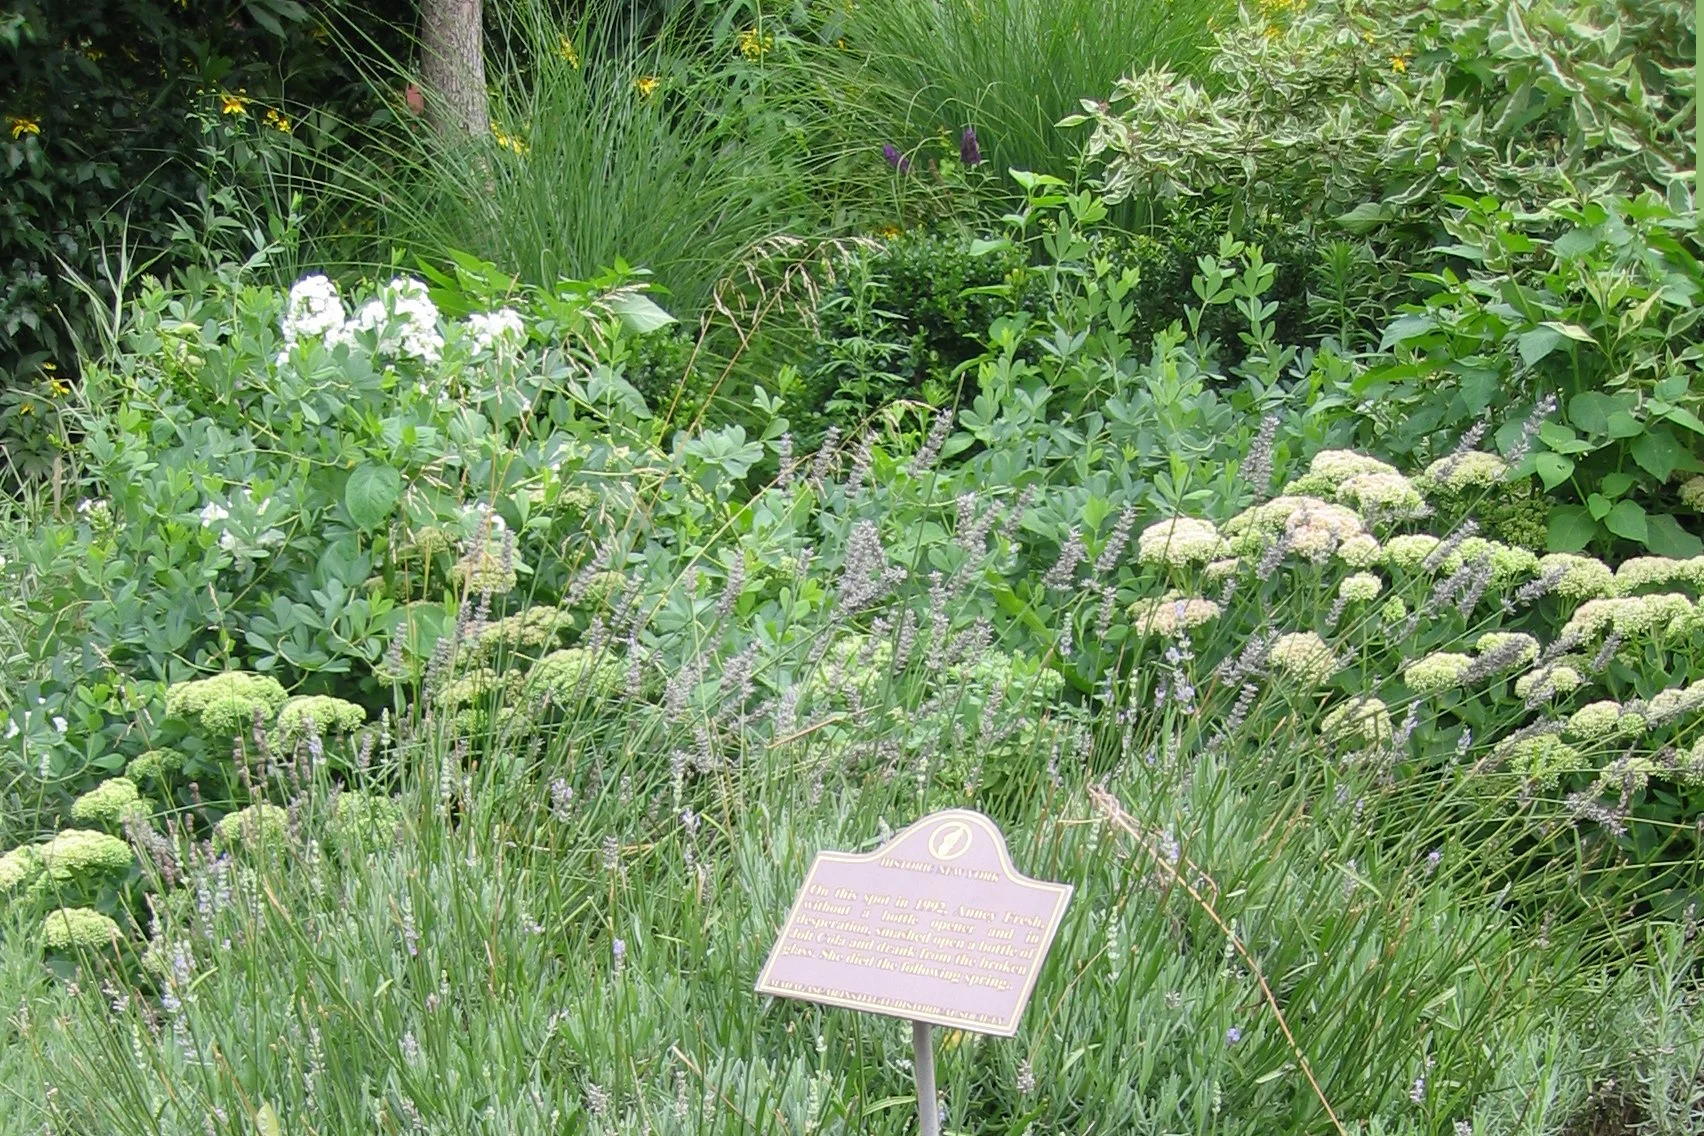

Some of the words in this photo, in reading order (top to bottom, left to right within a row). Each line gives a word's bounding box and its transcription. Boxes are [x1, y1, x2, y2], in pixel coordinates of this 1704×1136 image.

[880, 857, 934, 873] HISTORIC
[936, 866, 965, 876] NEW
[966, 869, 999, 882] YORK
[808, 884, 829, 896] On
[833, 888, 857, 900] this
[863, 894, 890, 907] spot
[894, 896, 908, 908] in
[803, 900, 851, 915] without
[881, 910, 918, 925] bottle
[930, 920, 975, 935] opener
[988, 926, 1014, 940] and
[1025, 931, 1039, 944] in
[788, 928, 815, 941] Jolt
[816, 933, 845, 947] Cola
[848, 939, 873, 951] and
[876, 940, 916, 958] drank
[918, 949, 951, 963] from
[954, 953, 976, 967] the
[979, 957, 1027, 975] broken
[875, 928, 930, 943] smashed
[931, 936, 964, 950] open
[978, 941, 1017, 957] bottle
[1019, 947, 1035, 960] of
[819, 949, 843, 961] She
[846, 952, 874, 966] died
[876, 958, 897, 970] the
[900, 962, 961, 982] following
